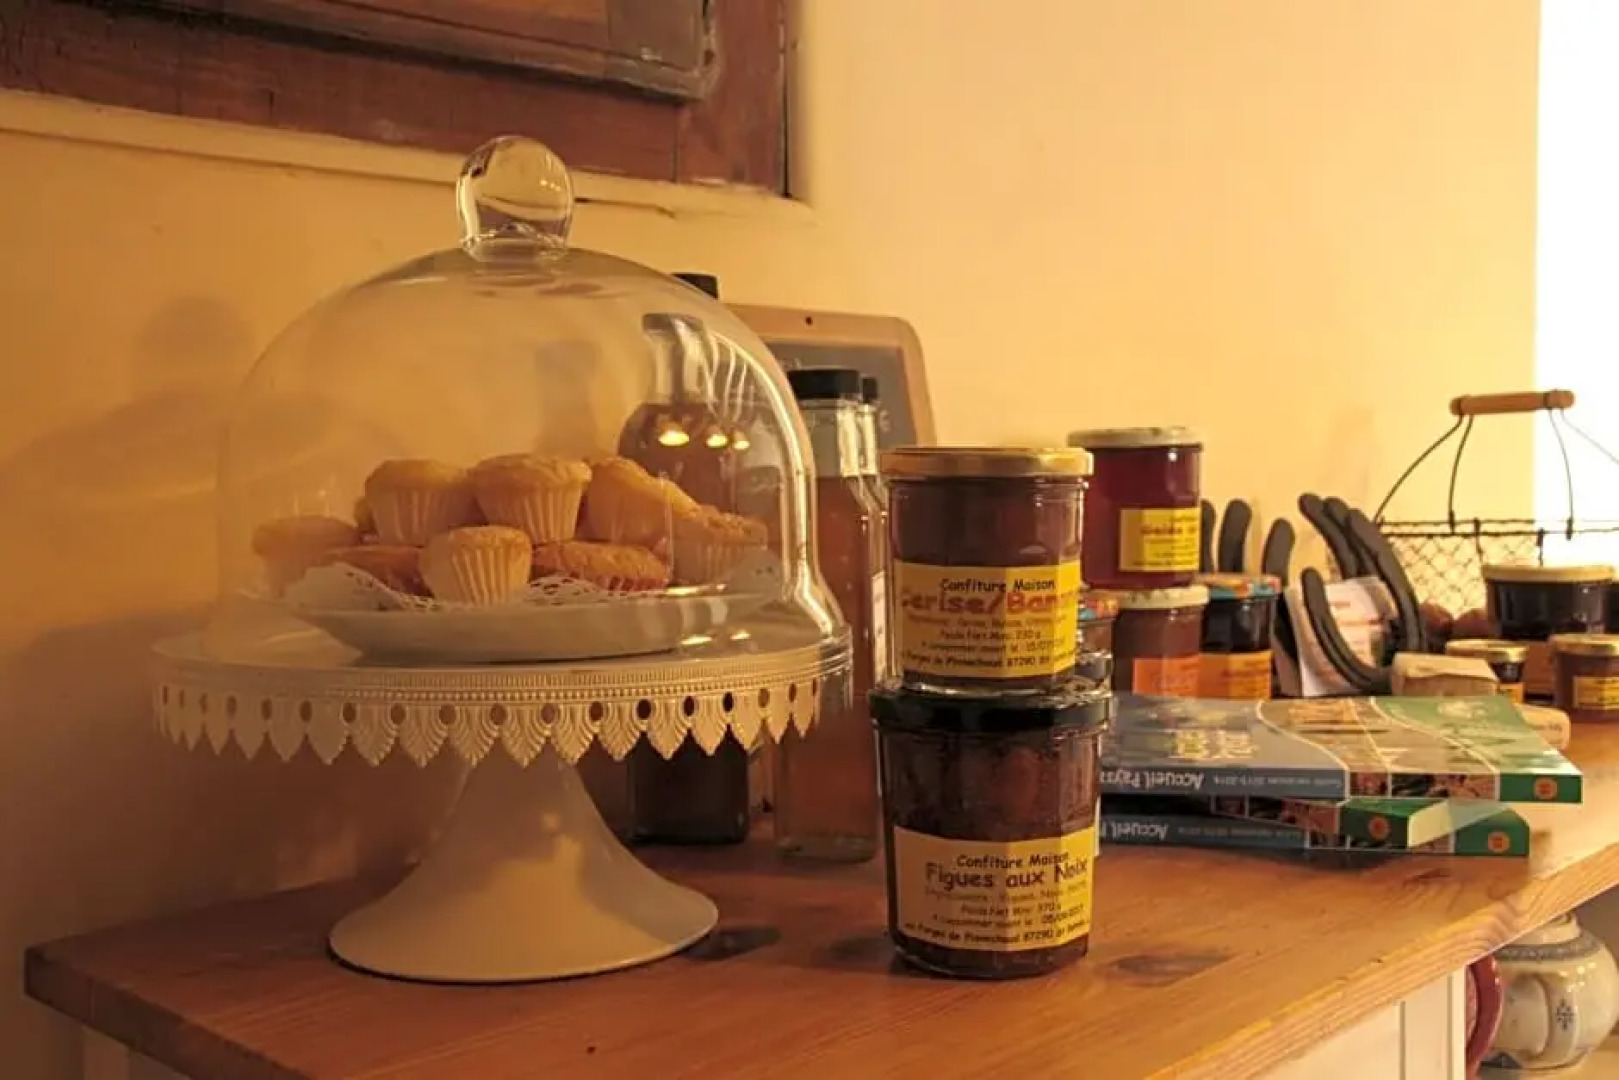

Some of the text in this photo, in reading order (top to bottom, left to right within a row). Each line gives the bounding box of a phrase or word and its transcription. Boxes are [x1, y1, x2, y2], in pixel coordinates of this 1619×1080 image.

[941, 578, 1055, 593] Confiture Maison
[1144, 770, 1205, 790] Accueil
[1112, 821, 1169, 840] Accueil
[956, 854, 1023, 869] Confiture
[926, 862, 994, 891] Figues
[1005, 870, 1044, 888] aux
[1054, 858, 1087, 883] Noix
